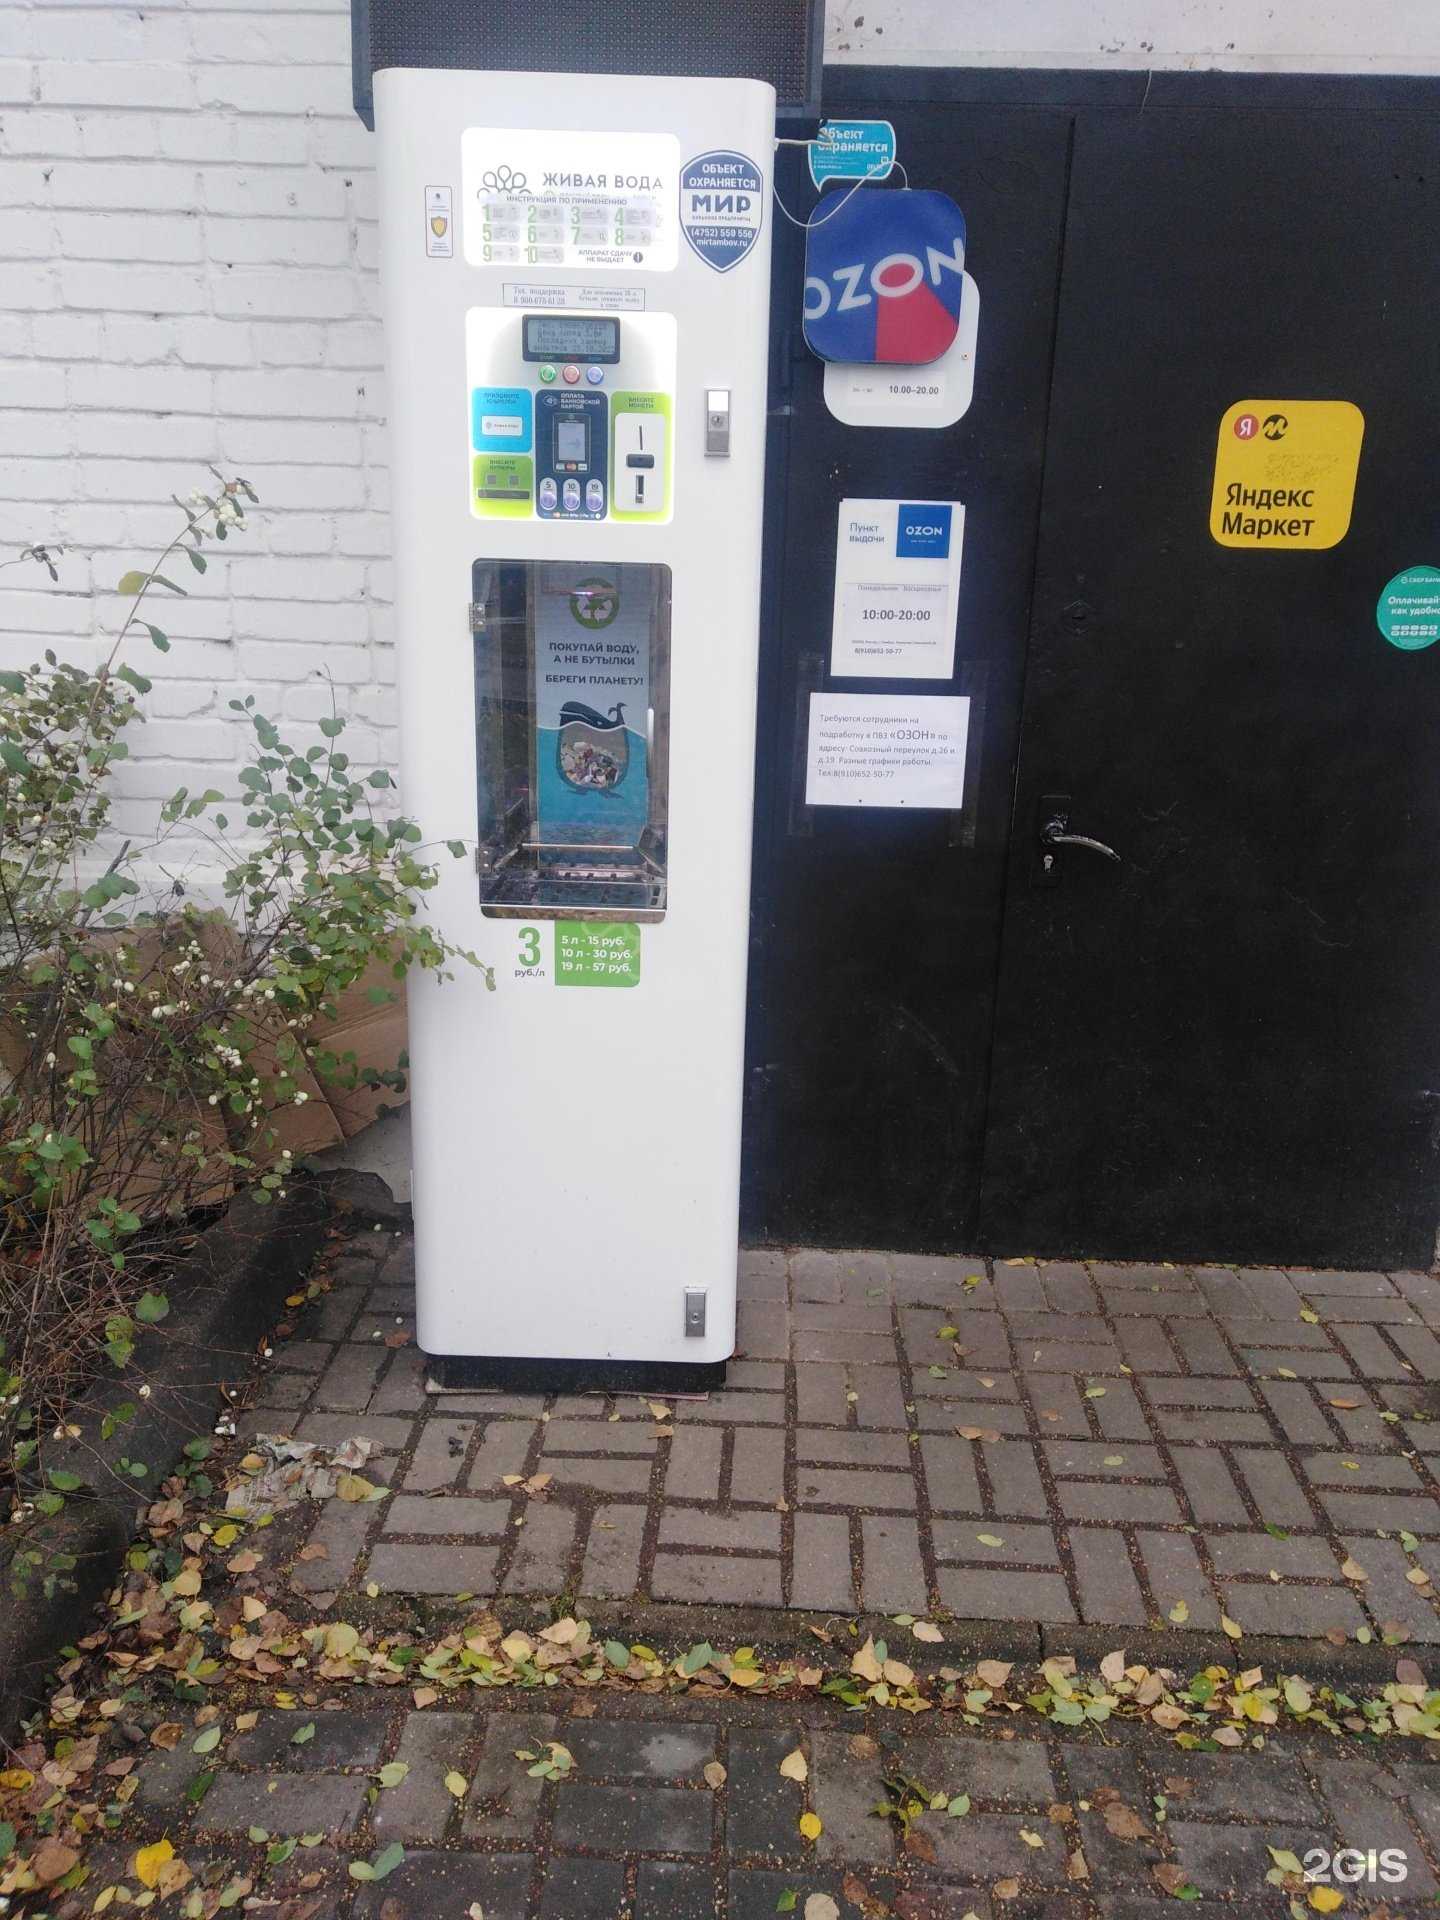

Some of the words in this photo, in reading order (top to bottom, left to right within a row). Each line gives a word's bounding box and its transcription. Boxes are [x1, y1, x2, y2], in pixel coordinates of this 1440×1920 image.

[702, 163, 745, 175] ОБЪЕКТ
[542, 172, 607, 188] ЖИВАЯ
[614, 175, 663, 190] ВОДА
[689, 177, 756, 190] ОХРАНЯЕТСЯ
[506, 195, 557, 205] ИНСТРУКЦИЯ
[558, 196, 570, 205] ПО
[571, 197, 628, 206] ПРИМЕНЕНИЮ
[692, 194, 751, 213] МИР
[527, 205, 537, 223] 2
[571, 206, 580, 224] 3
[614, 208, 624, 226] 4
[482, 224, 492, 242] 5
[527, 226, 537, 243] 6
[571, 227, 580, 245] 7
[614, 228, 624, 246] 8
[691, 228, 718, 238] (4752)
[696, 237, 748, 248] mirtambov.ru
[482, 244, 492, 262] 9
[805, 237, 965, 320] OZON
[1239, 417, 1252, 437] Я
[1225, 483, 1314, 511] Яндекс
[849, 522, 879, 535] Пункт
[905, 526, 943, 536] OZON
[1221, 511, 1316, 539] Маркет
[849, 534, 885, 545] выдачи
[1388, 595, 1440, 606] Оплачивай
[862, 609, 931, 621] 10:00-20:00
[1391, 607, 1408, 615] как
[549, 641, 603, 653] ПОКУПАЙ
[606, 643, 640, 655] ВОДУ,
[553, 655, 560, 663] А
[564, 655, 578, 664] НЕ
[582, 656, 635, 666] БУТЫЛКИ
[545, 674, 586, 684] БЕРЕГИ
[589, 675, 644, 686] ПЛАНЕТУ!
[820, 714, 860, 723] Требуются
[862, 715, 908, 725] сотрудники
[819, 730, 864, 740] подработку
[872, 731, 888, 739] ПВЗ
[890, 729, 936, 740] «ОЗОН»
[893, 746, 930, 756] переулок
[868, 758, 901, 767] графики
[518, 926, 541, 967] 3
[561, 935, 568, 944] 5
[571, 937, 578, 945] л
[587, 936, 599, 945] 15
[601, 936, 625, 948] руб.
[561, 948, 574, 957] 10
[576, 950, 583, 958] л
[593, 949, 607, 958] 30
[609, 949, 633, 961] руб.
[514, 967, 545, 978] руб./л
[561, 961, 573, 971] 19
[575, 963, 582, 971] л
[592, 962, 606, 971] 57
[608, 963, 632, 974] руб.
